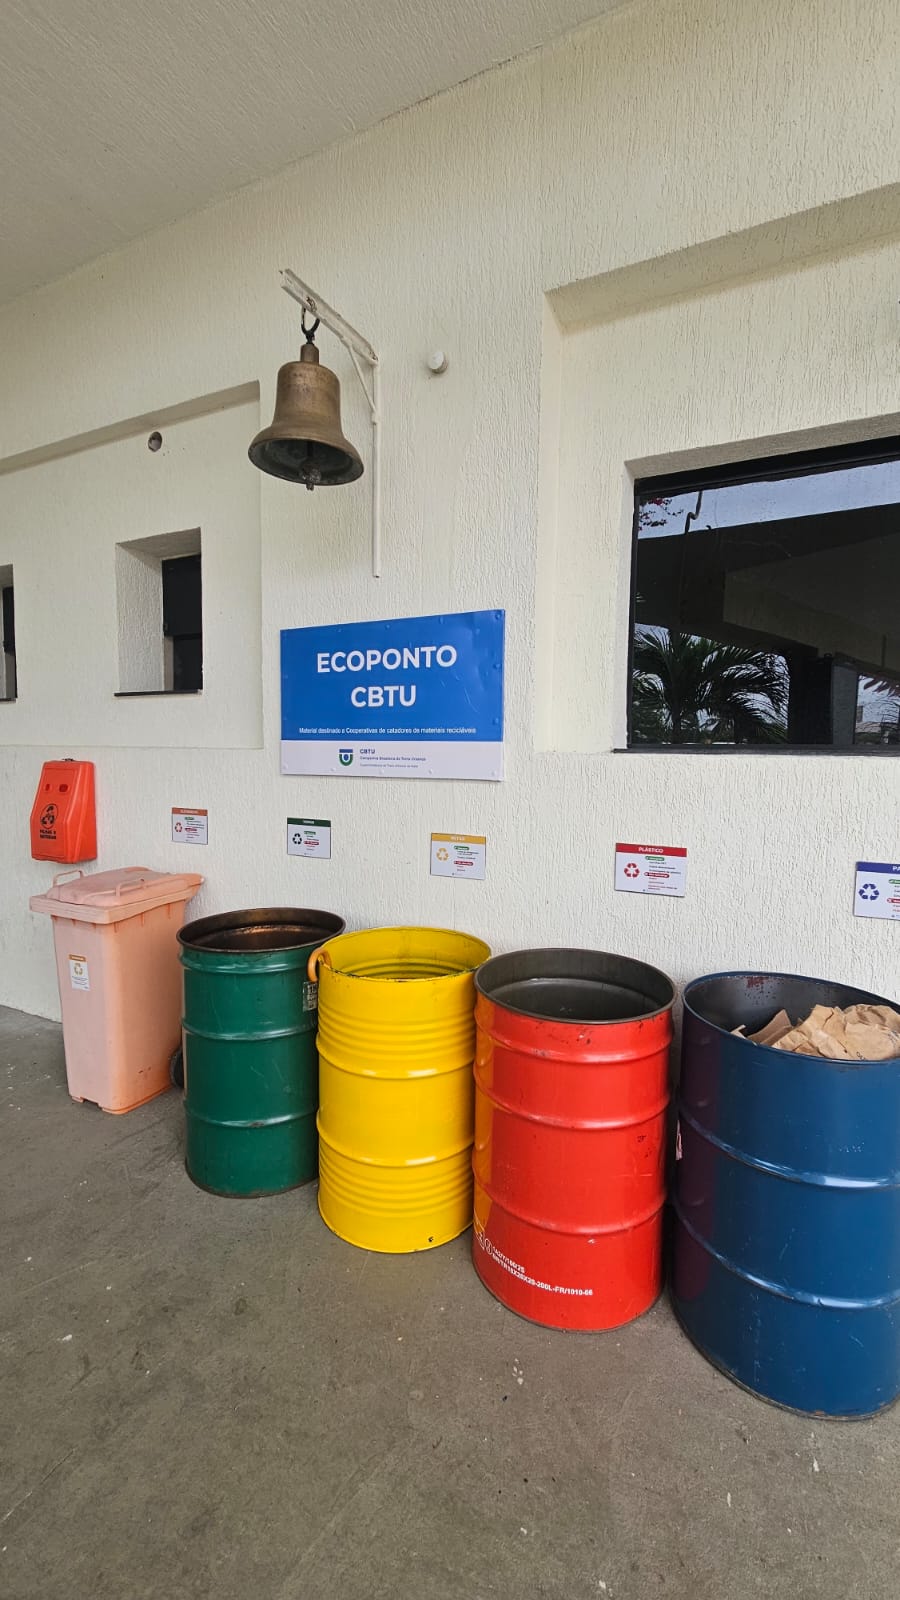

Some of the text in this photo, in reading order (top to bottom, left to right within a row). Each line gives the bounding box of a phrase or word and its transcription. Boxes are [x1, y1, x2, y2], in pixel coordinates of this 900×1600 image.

[317, 645, 457, 673] ECOPONTO
[350, 684, 417, 708] CBTU
[346, 727, 378, 735] Cooperativas
[638, 846, 664, 854] PLÁSTICO
